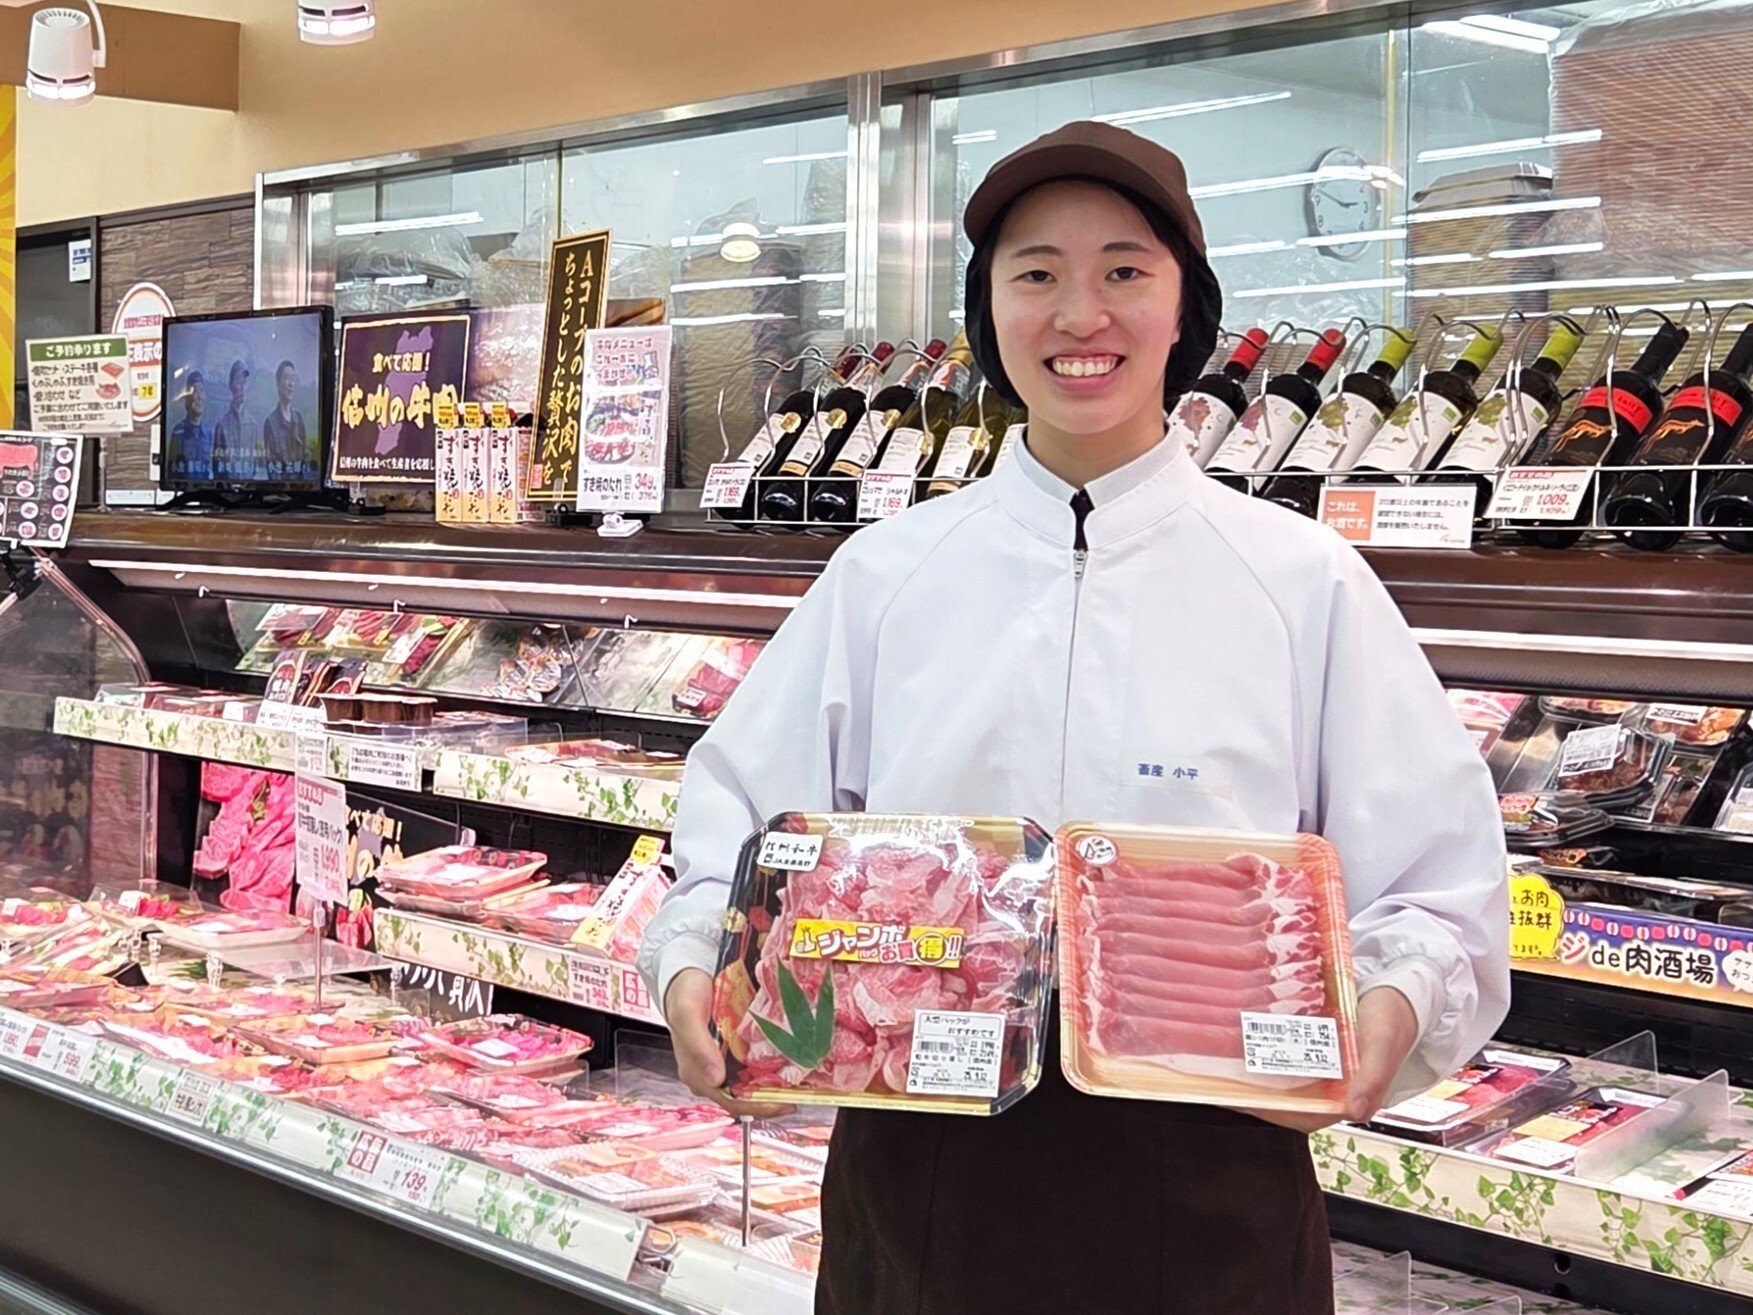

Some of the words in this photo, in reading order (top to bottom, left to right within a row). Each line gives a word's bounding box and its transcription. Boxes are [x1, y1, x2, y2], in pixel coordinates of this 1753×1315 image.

[45, 342, 111, 358] ご予約承ります
[542, 251, 576, 485] ちょっとした贅沢を
[558, 249, 594, 484] Aコープのお肉で
[1326, 501, 1360, 512] これは、
[1138, 763, 1164, 777] 畜産
[1172, 766, 1198, 780] 小平
[346, 805, 403, 842] べて応援！
[816, 924, 906, 956] ジャンボ
[400, 1169, 427, 1191] 139
